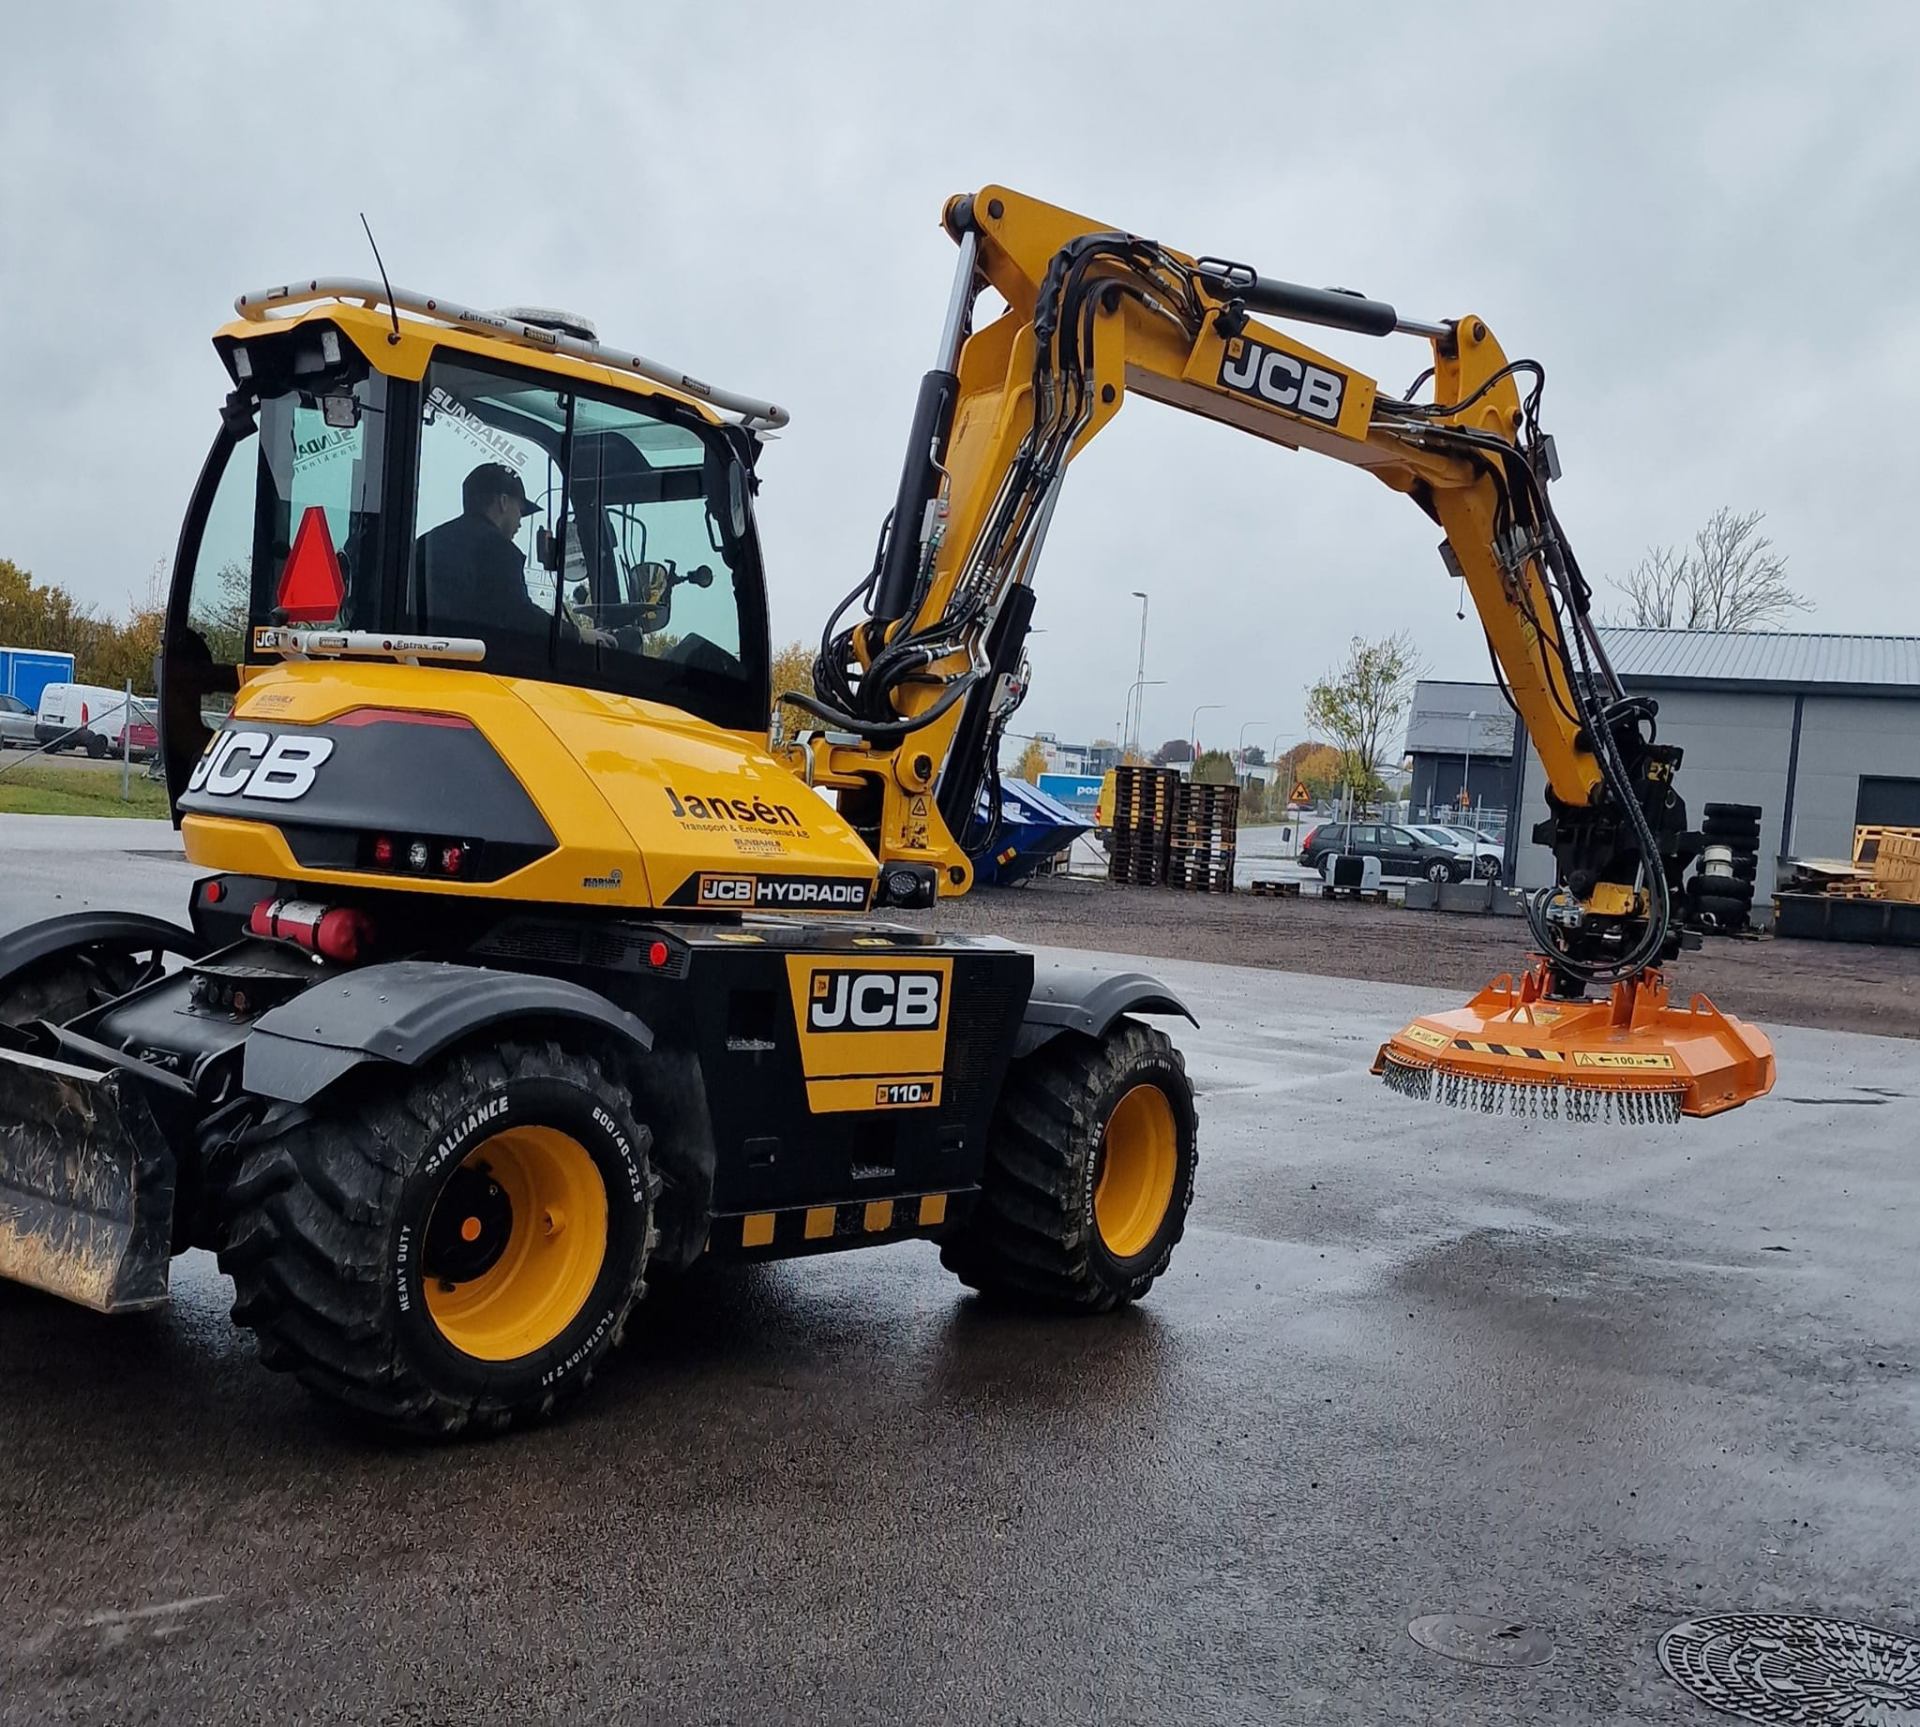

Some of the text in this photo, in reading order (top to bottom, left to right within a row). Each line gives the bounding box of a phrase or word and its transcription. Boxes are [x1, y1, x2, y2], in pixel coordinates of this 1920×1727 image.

[1223, 344, 1342, 420] JCB
[428, 386, 529, 468] SUNDAHLS
[188, 730, 334, 800] JCB
[664, 786, 802, 827] Jansén
[679, 821, 729, 833] Transport
[730, 824, 738, 832] &
[703, 879, 865, 903] JCB HYDRADIG
[811, 974, 939, 1027] JCB
[1613, 1056, 1635, 1066] 100
[440, 1095, 509, 1162] ALLIANCE
[397, 1225, 412, 1312] HEAVY DUTY
[565, 1310, 614, 1370] FLOTATION
